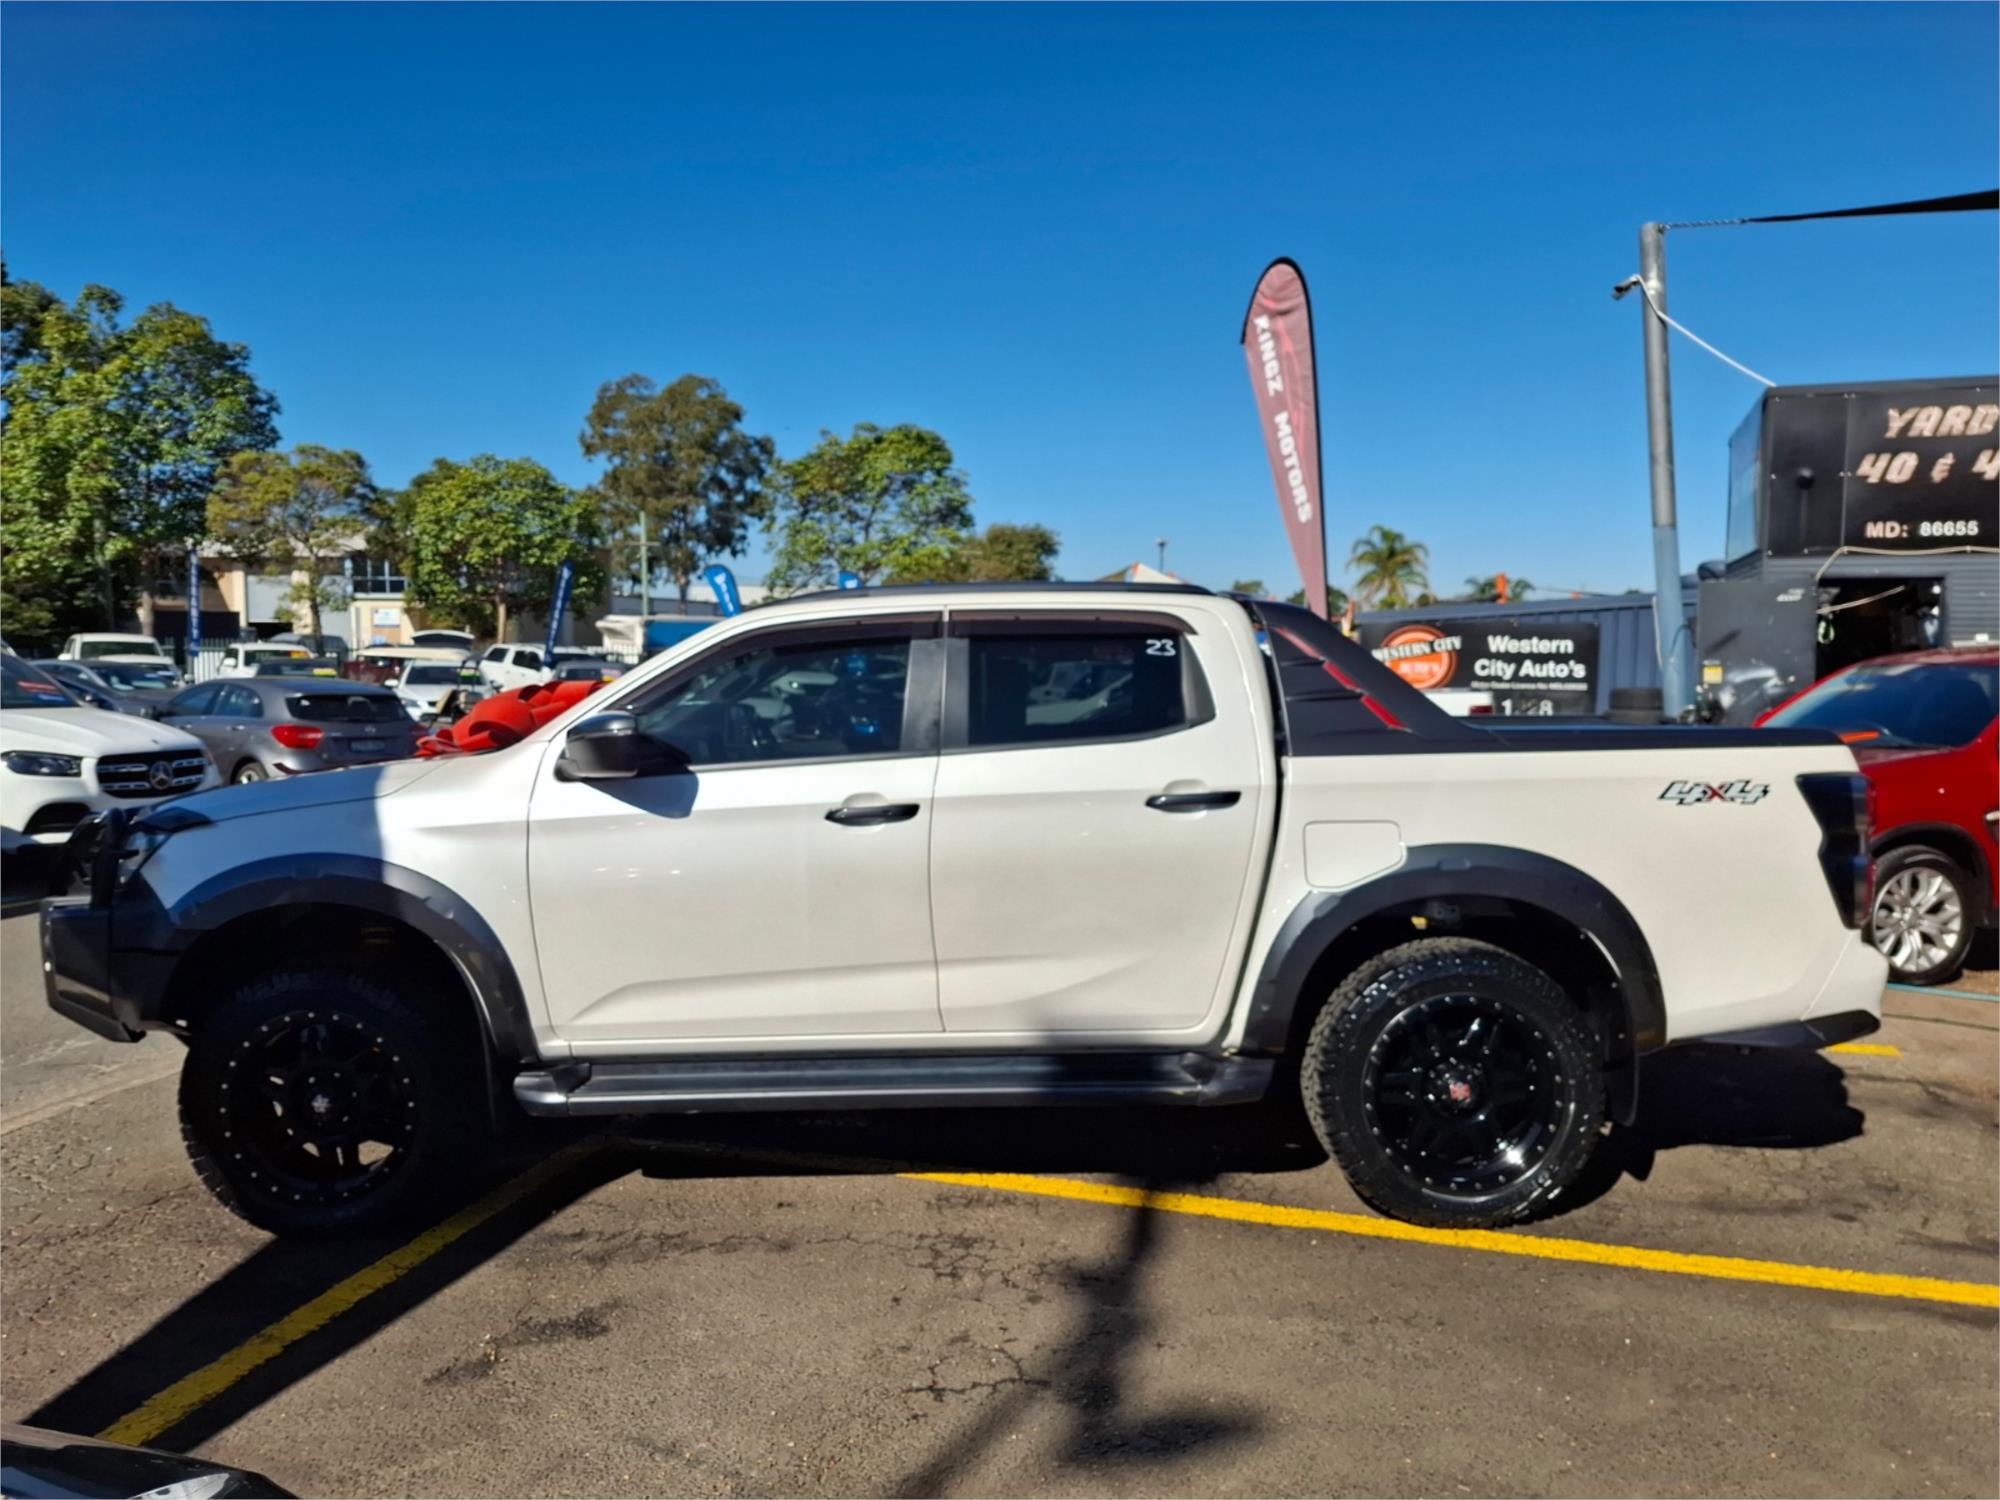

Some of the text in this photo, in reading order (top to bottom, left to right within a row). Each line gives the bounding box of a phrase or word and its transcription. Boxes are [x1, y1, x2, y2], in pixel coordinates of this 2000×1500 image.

[1253, 314, 1313, 524] KINGZ MOTORS
[1884, 404, 2000, 439] YARD
[1856, 451, 1919, 484] 40
[1866, 520, 1979, 538] MD: 86655
[1146, 638, 1176, 656] 23
[1433, 635, 1462, 653] CITY
[1487, 634, 1574, 654] Western
[1474, 658, 1586, 680] City Auto's
